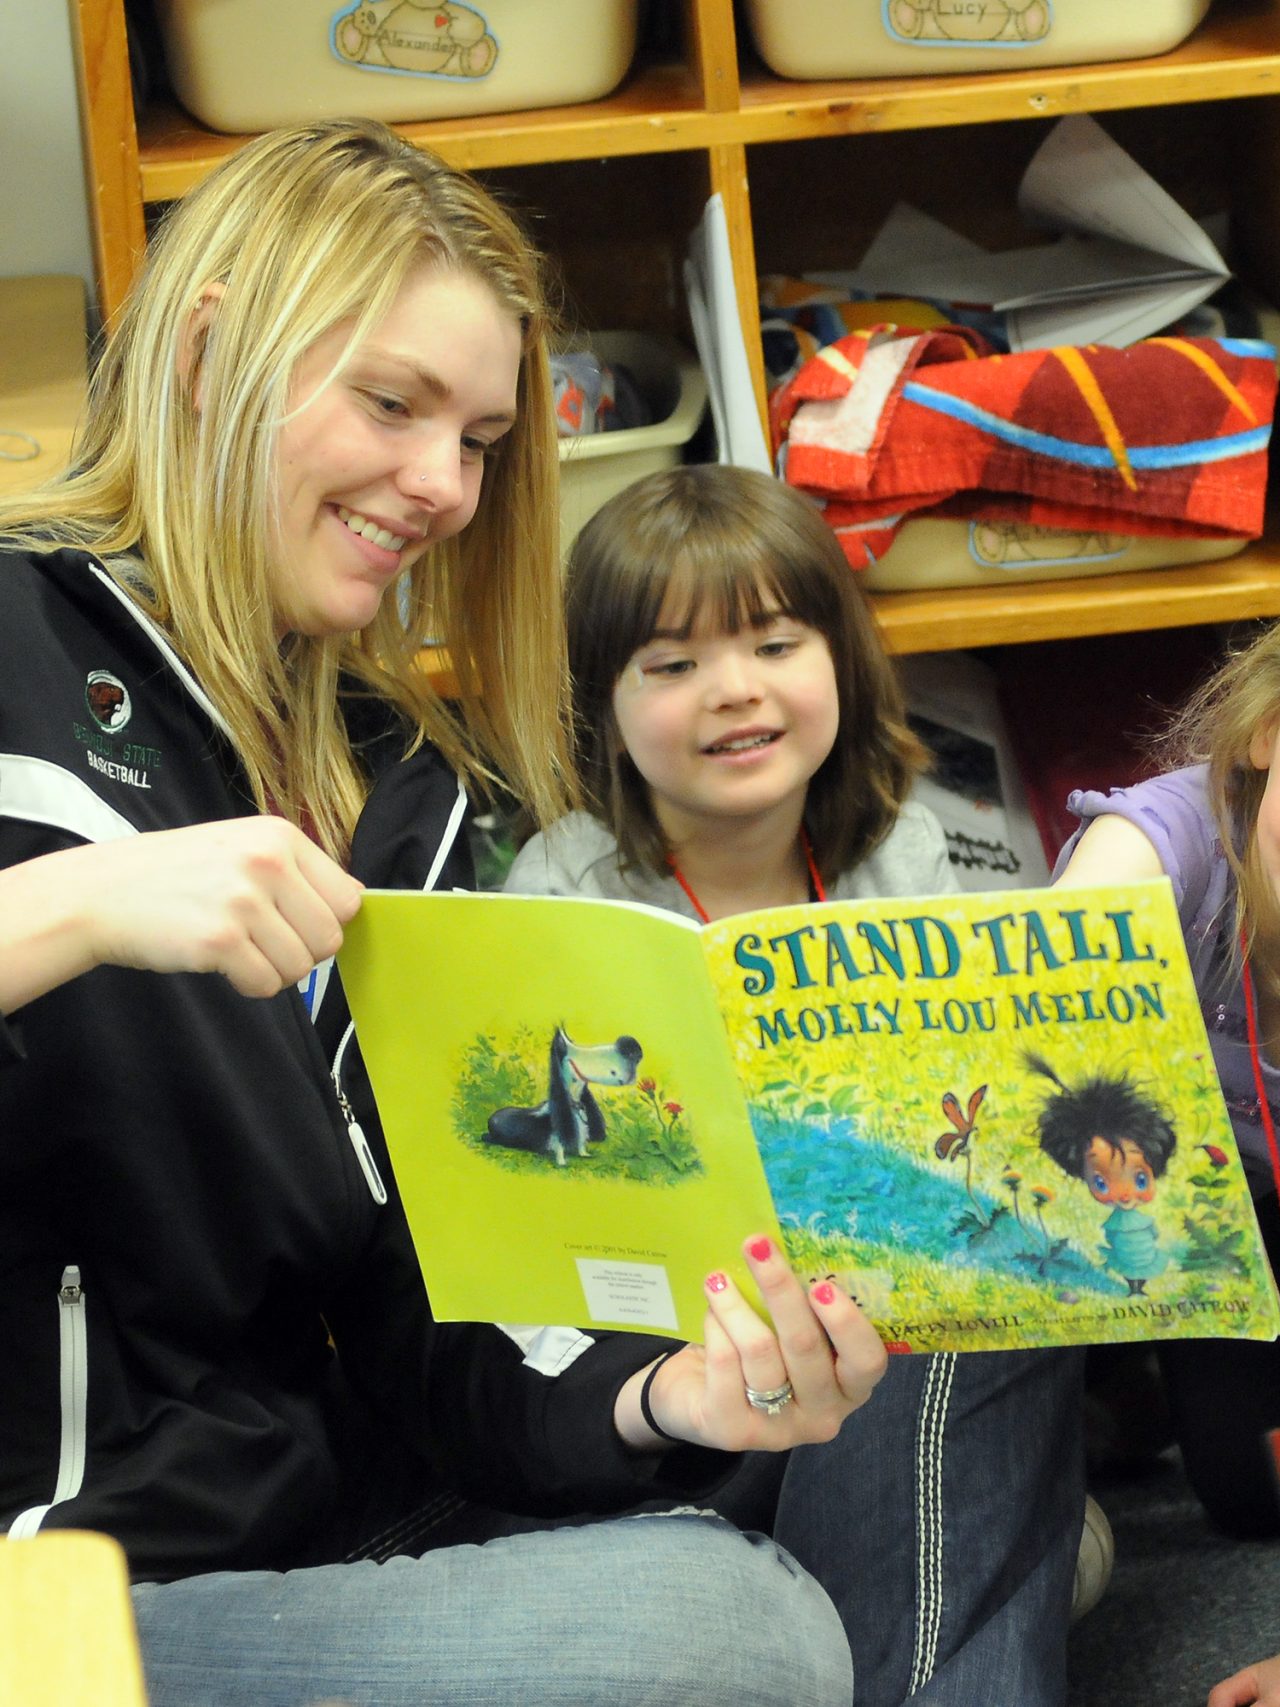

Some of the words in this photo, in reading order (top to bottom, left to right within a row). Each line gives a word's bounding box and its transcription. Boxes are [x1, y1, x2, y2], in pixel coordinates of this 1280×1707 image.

[937, 0, 988, 24] Lucy
[86, 749, 152, 789] BASKETBALL
[122, 743, 162, 768] STATE
[734, 915, 961, 996] STAND
[972, 910, 1168, 976] TALL,
[754, 998, 902, 1050] MOLLY
[913, 998, 996, 1034] LOU
[1010, 983, 1167, 1030] MELON
[890, 1320, 949, 1339] PATTY
[1111, 1302, 1173, 1321] DAVID
